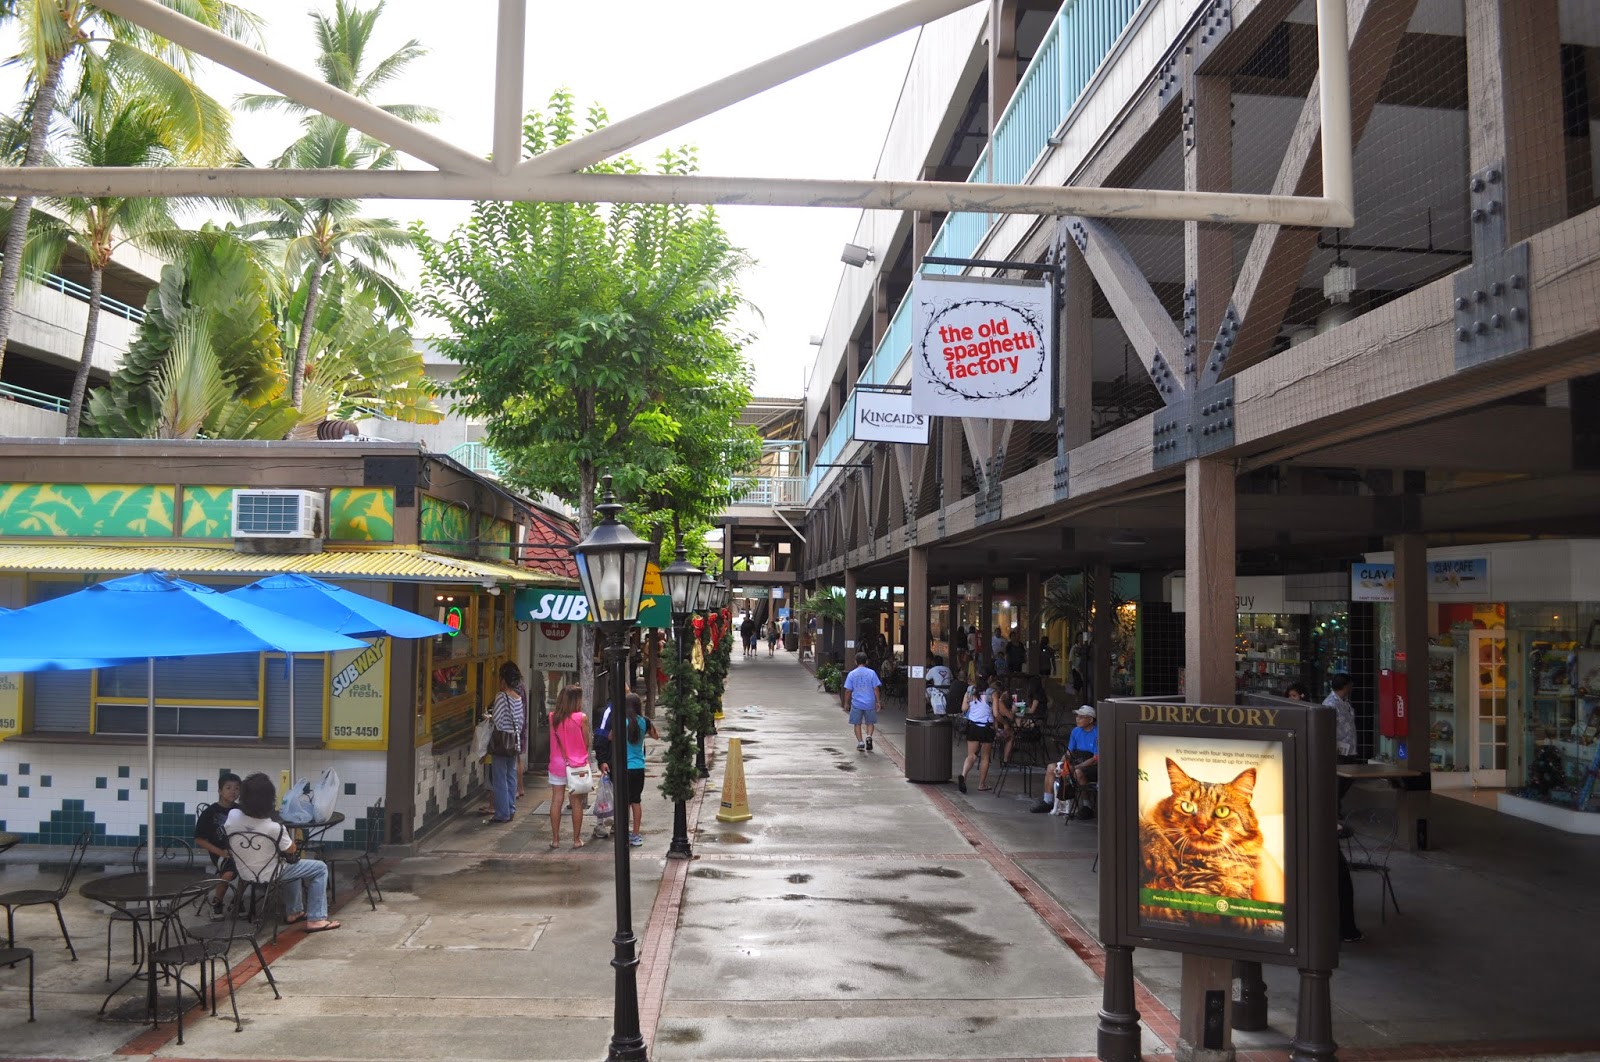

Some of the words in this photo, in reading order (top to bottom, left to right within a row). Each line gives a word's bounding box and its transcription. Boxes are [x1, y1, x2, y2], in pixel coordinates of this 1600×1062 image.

[938, 324, 974, 344] the
[978, 317, 1010, 339] old
[943, 332, 1036, 362] spaghetti
[945, 354, 1020, 380] factory
[860, 408, 924, 427] KINCAID'S
[1360, 569, 1388, 580] CLAY
[1434, 562, 1452, 574] CLAY
[1453, 561, 1473, 572] CAFE
[1235, 595, 1255, 610] guy
[545, 629, 565, 637] WARD
[332, 637, 385, 697] SUBWAY
[349, 689, 382, 698] fresh.
[352, 683, 372, 691] eat
[1139, 705, 1279, 726] DIRECTORY
[334, 726, 379, 737] 593-4450
